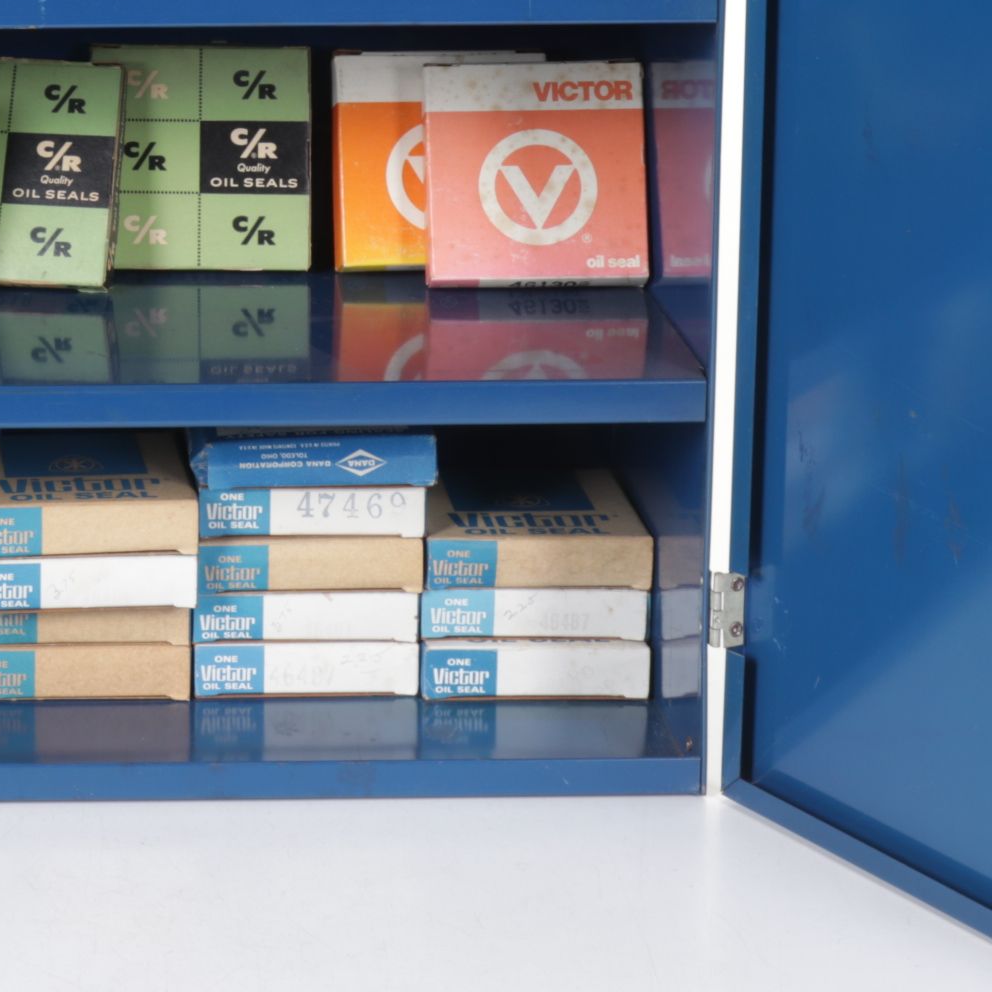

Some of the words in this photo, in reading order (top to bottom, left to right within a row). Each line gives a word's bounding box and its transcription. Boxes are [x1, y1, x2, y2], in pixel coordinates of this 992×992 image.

[533, 80, 634, 103] VICTOR
[236, 162, 271, 175] Quality
[40, 174, 74, 187] Quality
[210, 177, 239, 188] OIL
[243, 177, 299, 189] SEALS
[12, 187, 40, 200] OIL
[45, 189, 100, 202] SEALS
[586, 254, 605, 268] oil
[608, 254, 641, 268] seal
[239, 461, 304, 469] CORPORATION
[346, 459, 376, 467] DANA
[220, 493, 244, 501] ONE
[206, 503, 263, 520] Victor
[208, 521, 227, 529] OIL
[230, 521, 260, 529] SEAL
[213, 605, 237, 613] ONE
[199, 614, 256, 631] Victor
[430, 608, 487, 625] Victor
[214, 655, 238, 663] ONE
[447, 658, 472, 666] ONE
[201, 665, 257, 682] Victor
[433, 668, 490, 685] Victor
[435, 685, 454, 694] OIL
[456, 685, 486, 694] SEAL
